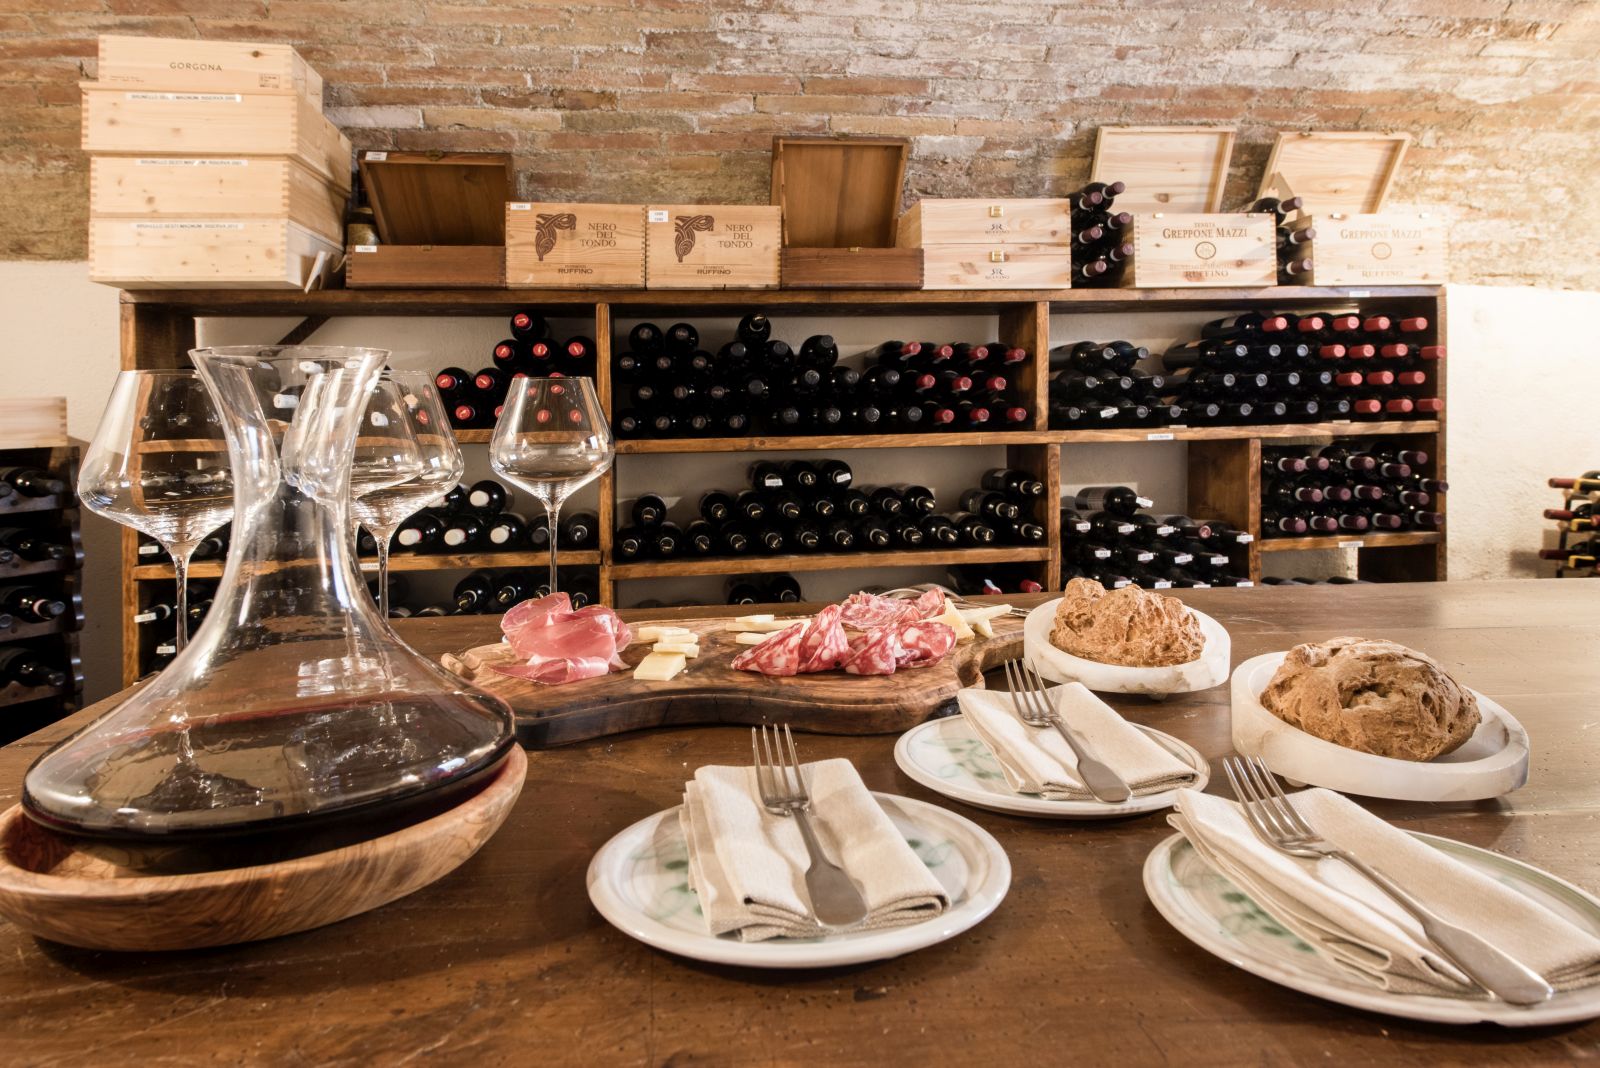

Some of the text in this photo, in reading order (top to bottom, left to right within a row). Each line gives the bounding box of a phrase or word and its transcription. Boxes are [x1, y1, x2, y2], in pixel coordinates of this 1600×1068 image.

[169, 61, 222, 72] GORGONA
[588, 222, 617, 232] NERO
[725, 224, 753, 233] NERO
[596, 231, 617, 240] DEL
[733, 232, 753, 241] DEL
[1162, 227, 1248, 239] GREPPONE MAZZI
[1340, 228, 1422, 240] GREPPONE MAZZI
[579, 239, 617, 248] TONDO
[717, 240, 753, 249] TONDO
[1184, 270, 1229, 278] RUFFINO
